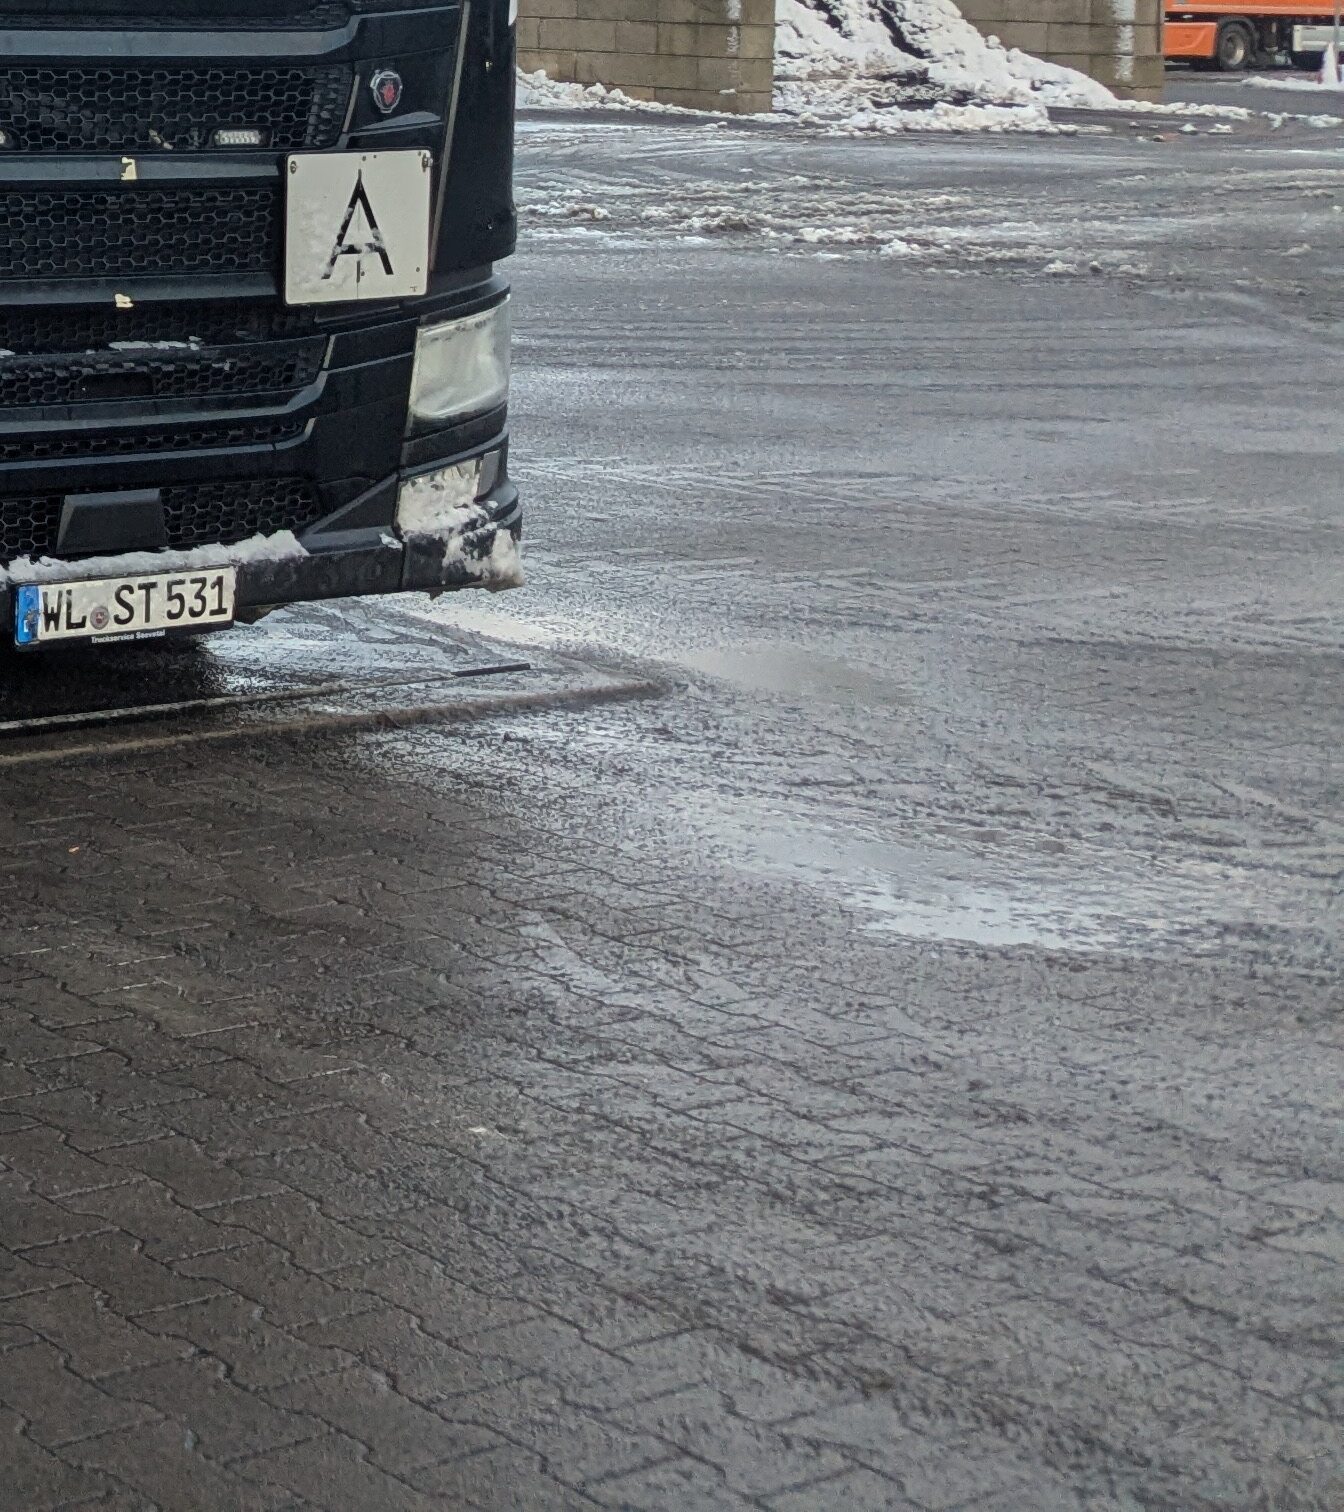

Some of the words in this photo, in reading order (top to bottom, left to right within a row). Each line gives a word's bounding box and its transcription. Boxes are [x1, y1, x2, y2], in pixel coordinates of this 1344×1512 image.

[321, 169, 394, 280] A
[42, 589, 87, 632] WL
[113, 582, 158, 625] ST
[167, 575, 228, 620] 531
